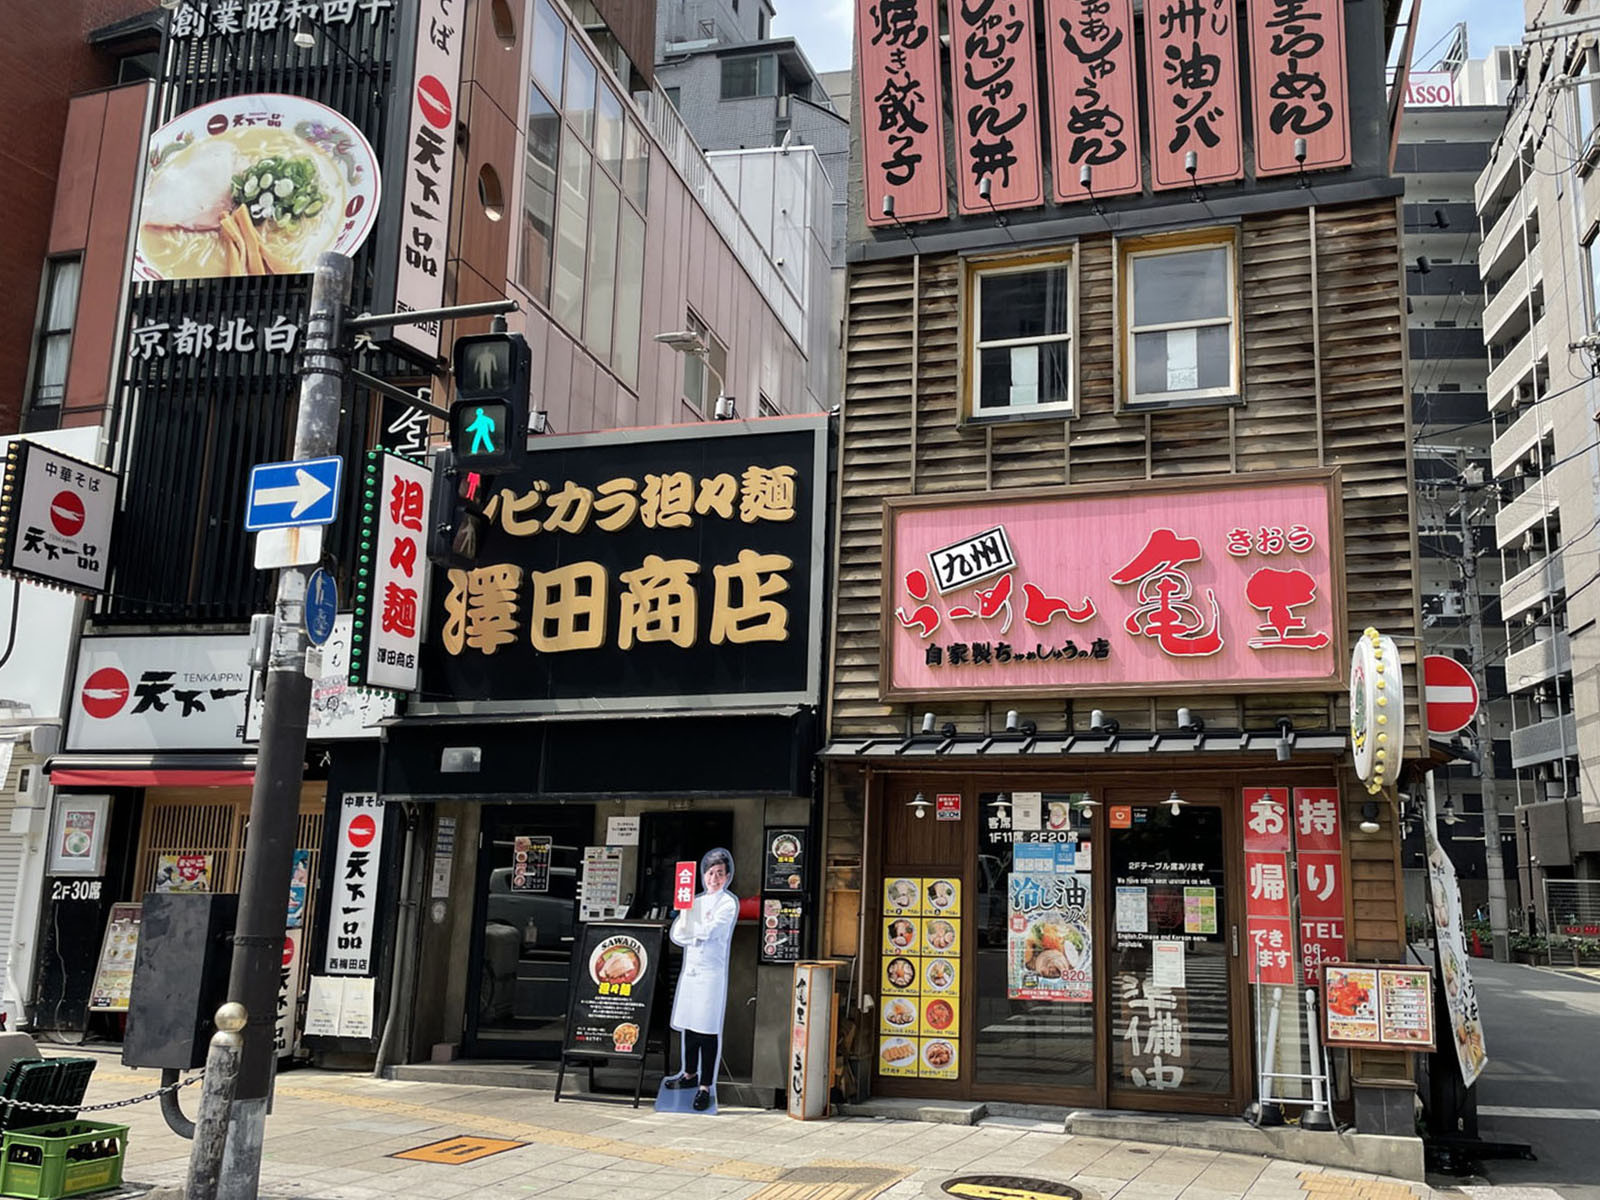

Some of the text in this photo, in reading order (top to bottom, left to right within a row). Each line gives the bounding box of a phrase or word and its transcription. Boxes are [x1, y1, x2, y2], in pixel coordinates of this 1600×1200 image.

[405, 125, 446, 277] 天下一品
[129, 315, 304, 360] 京都北白
[45, 461, 102, 492] 中華そば
[483, 466, 798, 536] ビカラ担々麺
[22, 526, 100, 572] 天下一品
[382, 475, 424, 639] 担々麺
[941, 536, 1003, 583] 九州
[1226, 525, 1316, 555] きおう
[442, 549, 794, 655] 澤田商店
[897, 568, 1096, 638] らーめん
[1110, 528, 1330, 657] 亀王
[183, 673, 243, 683] TENKAIPPIN
[52, 881, 102, 900] 2F30席
[338, 851, 371, 950] 天下一品
[677, 868, 693, 903] 合格
[1302, 923, 1343, 939] TEL
[1123, 974, 1184, 1091] 準備中
